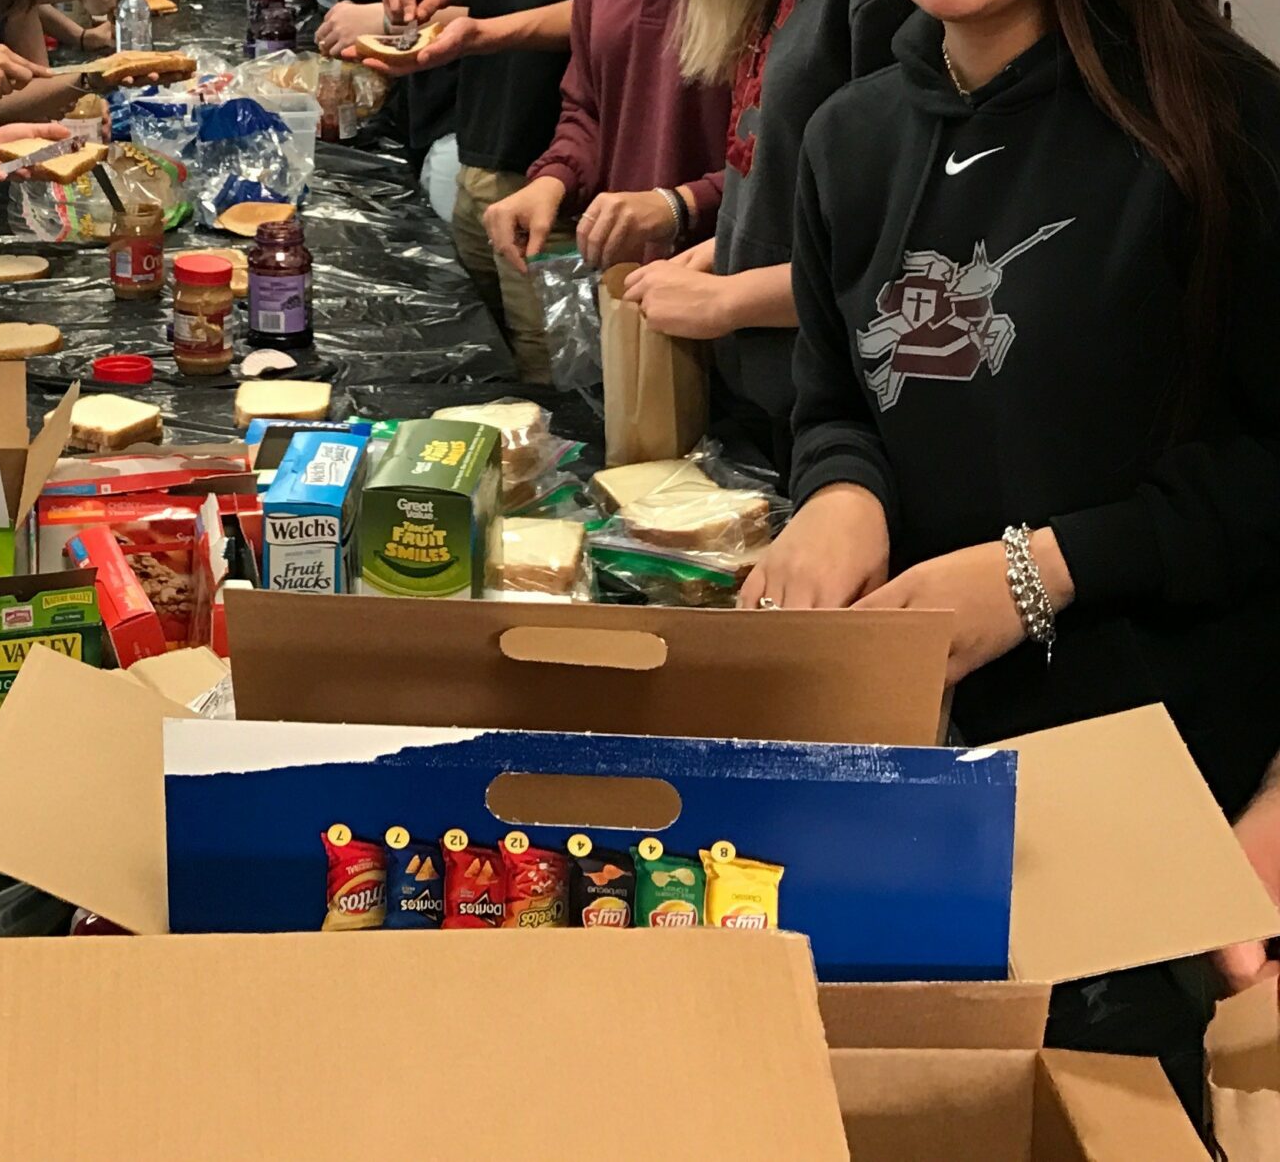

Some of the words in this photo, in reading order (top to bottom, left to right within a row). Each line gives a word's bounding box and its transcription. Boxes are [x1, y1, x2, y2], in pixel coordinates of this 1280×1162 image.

[397, 498, 434, 513] Great
[406, 510, 434, 520] Value
[269, 518, 336, 539] Welch's
[392, 526, 447, 547] FRUIT
[384, 542, 451, 563] SMILES
[285, 561, 324, 578] Fruit
[272, 574, 331, 590] Snacks
[2, 637, 78, 663] VAEY
[336, 830, 344, 840] 7
[394, 832, 402, 842] 7
[450, 835, 464, 846] 12
[510, 838, 525, 849] 12
[576, 841, 585, 851] 4
[648, 844, 657, 854] 4
[720, 847, 729, 858] 8
[339, 883, 387, 913] Fritos
[587, 886, 628, 897] Barbecue
[731, 893, 763, 903] Classic
[400, 898, 443, 912] Doritos
[460, 902, 502, 917] Doritos
[519, 898, 564, 928] Cheetos
